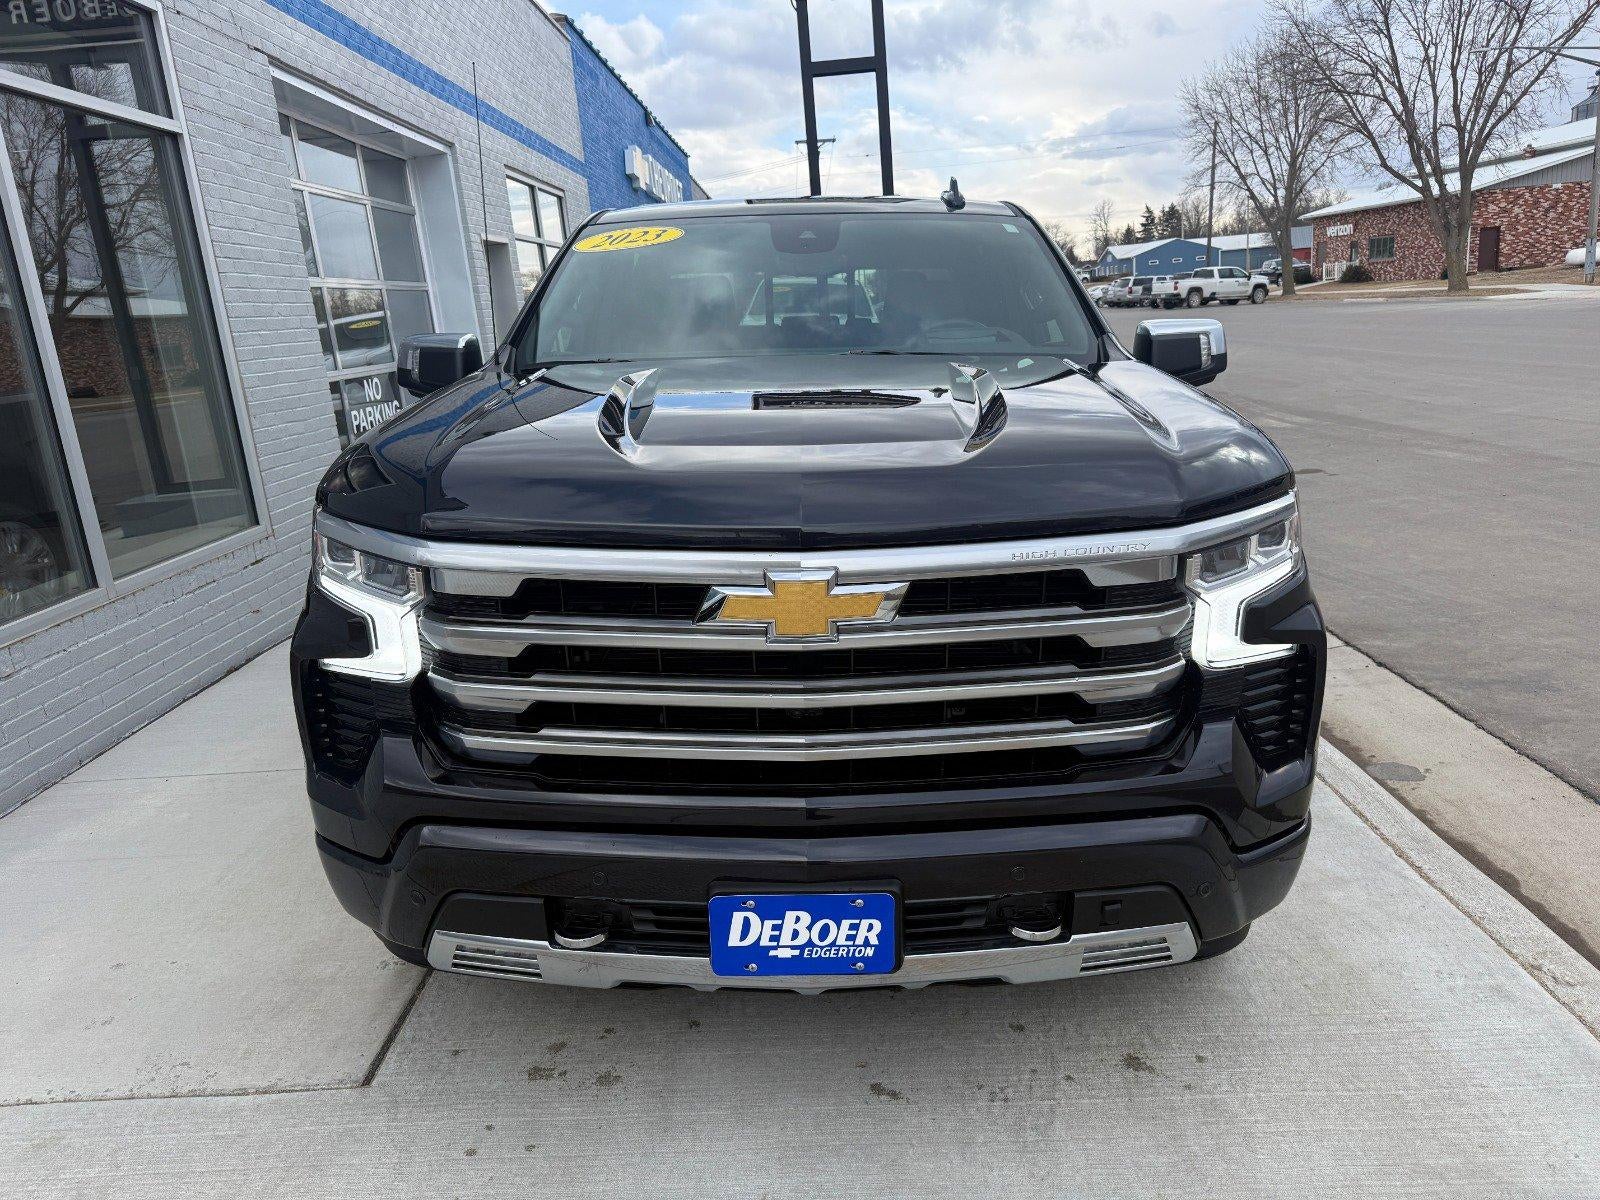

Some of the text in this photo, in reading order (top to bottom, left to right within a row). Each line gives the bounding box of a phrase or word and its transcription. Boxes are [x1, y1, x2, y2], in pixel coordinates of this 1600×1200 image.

[588, 229, 668, 249] 2023
[1326, 222, 1354, 237] verizon
[363, 377, 382, 402] NO
[351, 400, 400, 435] PARKING
[1011, 542, 1151, 560] HIGH COUNTRY
[804, 947, 875, 958] EDGERTON
